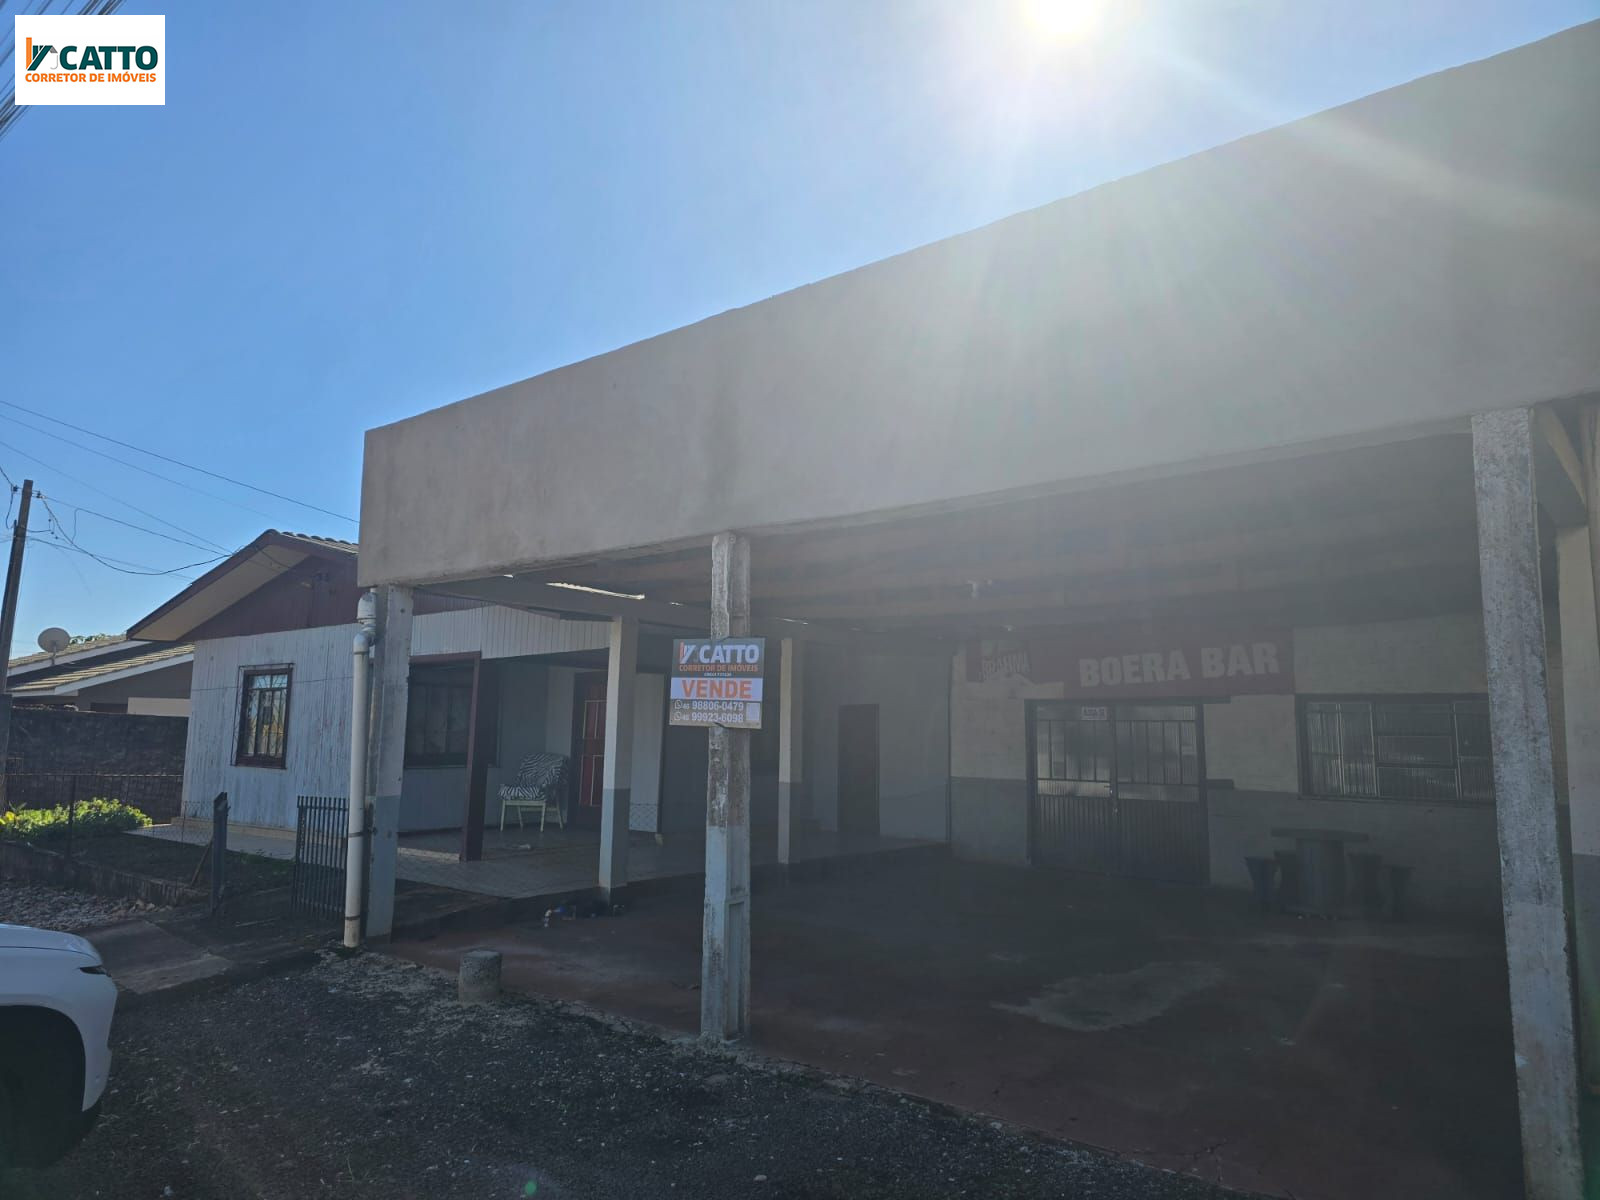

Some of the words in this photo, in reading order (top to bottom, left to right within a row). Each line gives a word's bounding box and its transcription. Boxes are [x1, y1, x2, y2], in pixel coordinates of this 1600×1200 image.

[699, 644, 759, 664] CATTO
[679, 664, 715, 672] CORRETOR
[717, 664, 726, 672] DE
[1079, 649, 1191, 688] BOERA
[1201, 642, 1280, 679] BAR
[682, 679, 752, 699] VENDE
[692, 700, 744, 712] 98806-0479
[691, 711, 744, 723] 99923-6098
